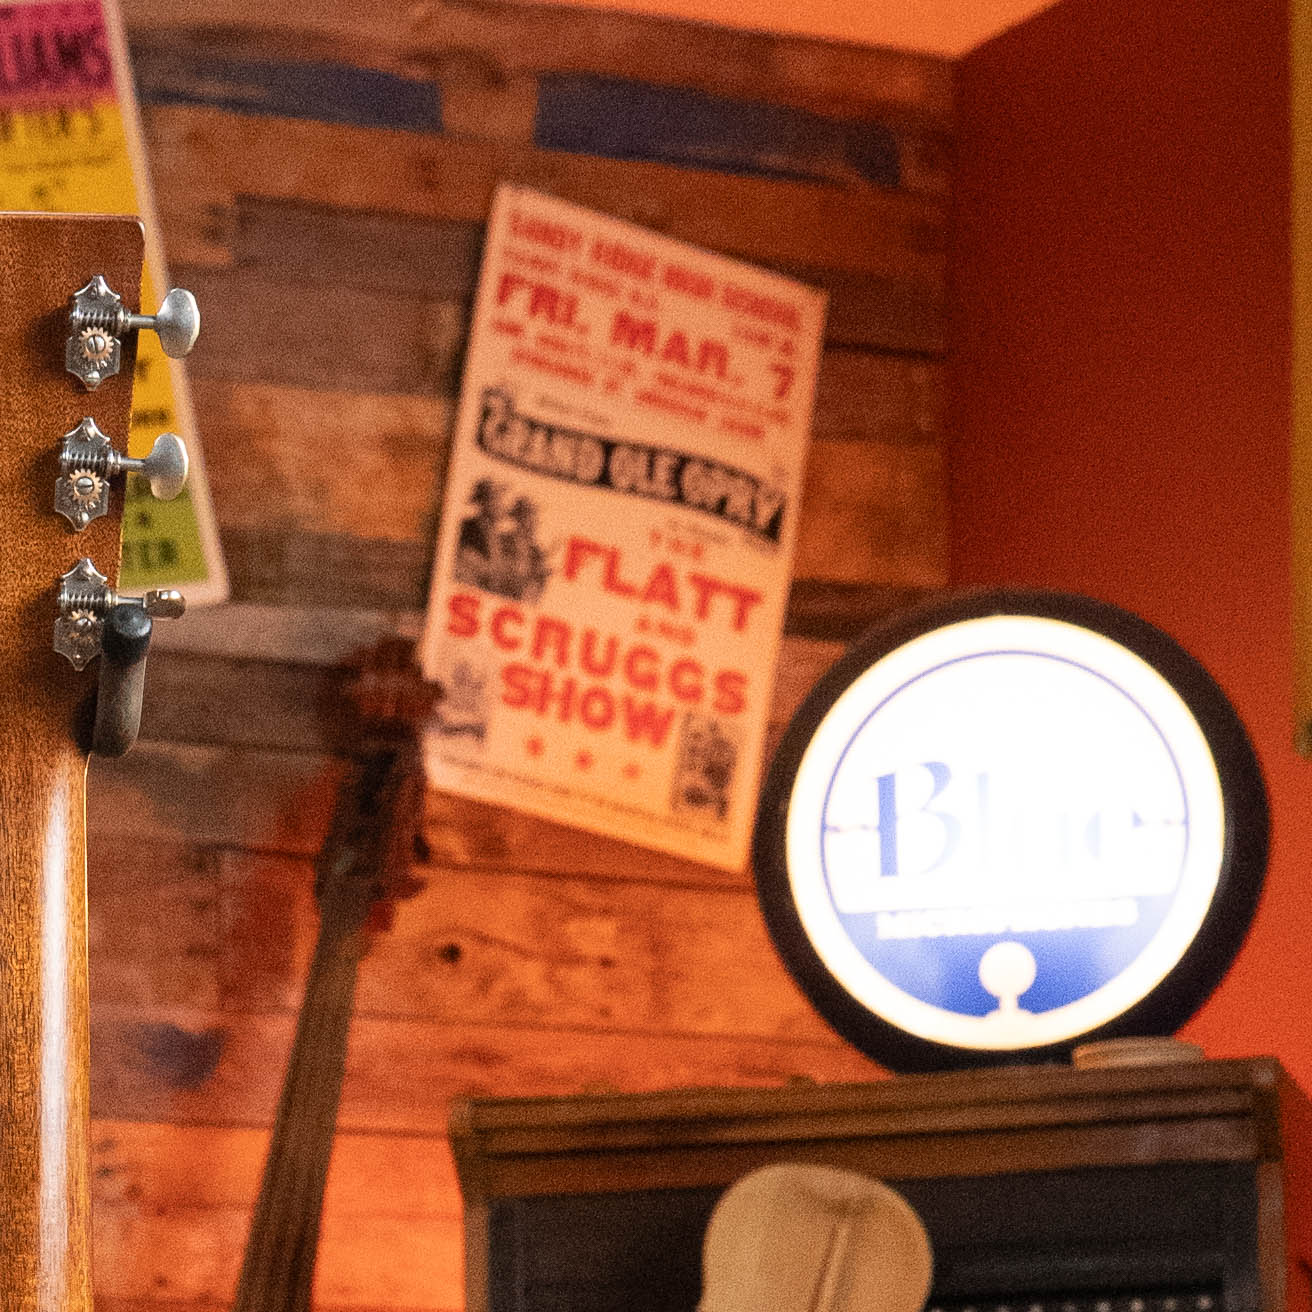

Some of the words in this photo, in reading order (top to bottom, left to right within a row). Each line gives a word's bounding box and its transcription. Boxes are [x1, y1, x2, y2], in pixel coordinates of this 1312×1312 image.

[768, 361, 796, 401] 7
[562, 535, 765, 632] FLATT
[446, 591, 751, 717] SCRUGGS
[500, 662, 675, 748] SHOW
